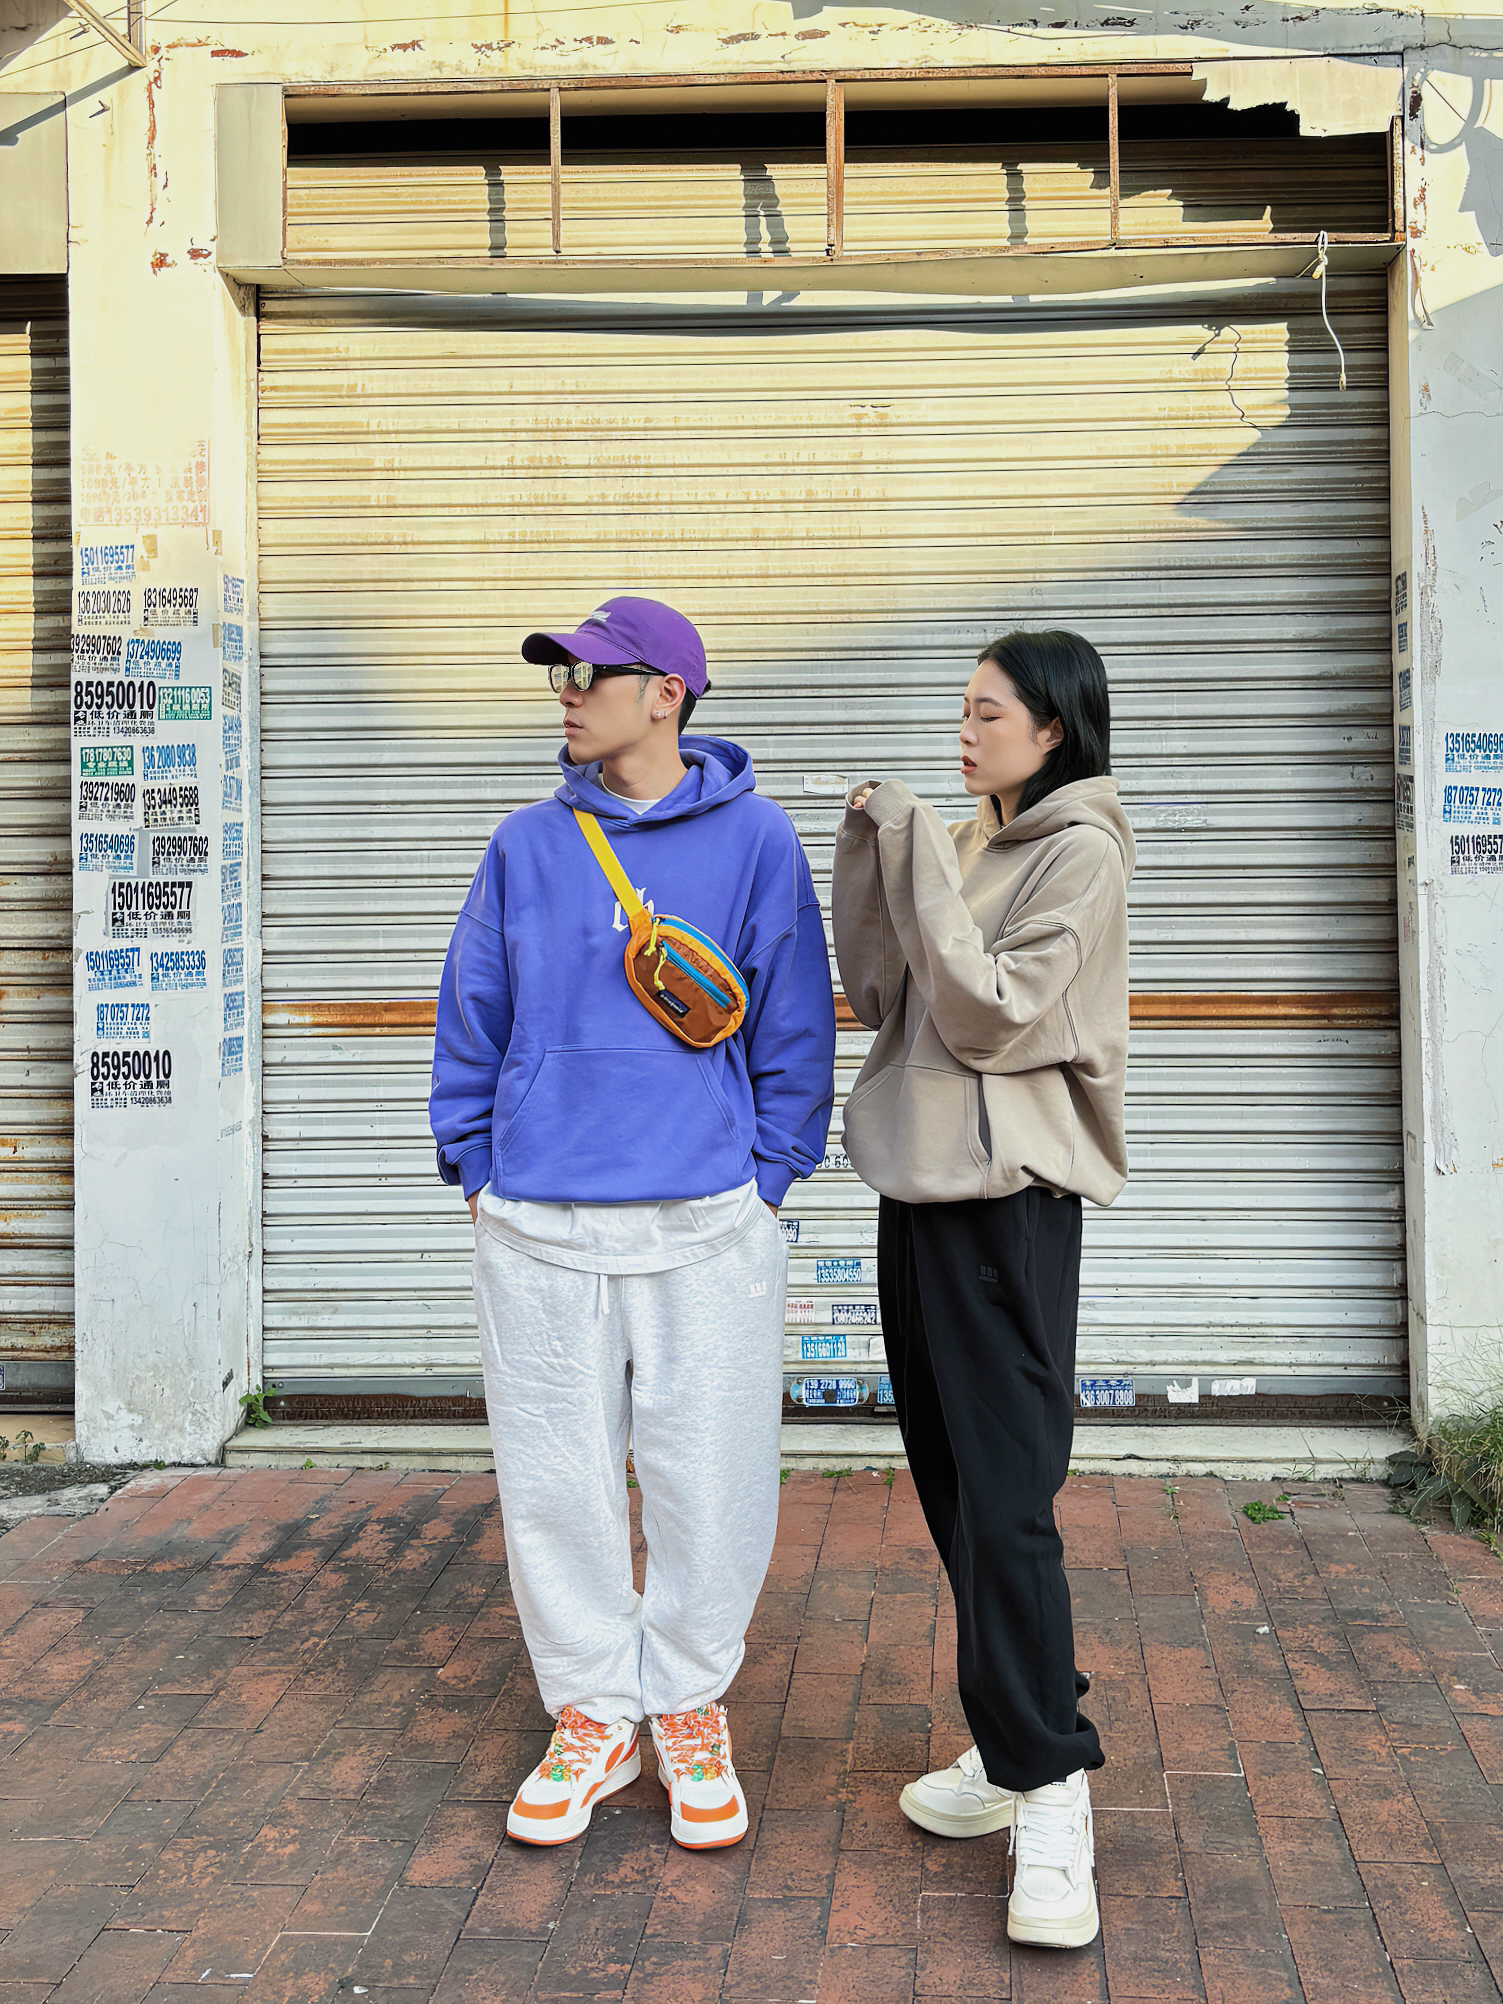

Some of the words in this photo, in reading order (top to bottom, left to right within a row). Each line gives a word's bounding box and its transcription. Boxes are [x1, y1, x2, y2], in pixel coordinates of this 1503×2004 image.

[80, 544, 135, 566] 15011695577
[126, 637, 182, 661] 13724906699
[74, 680, 156, 710] 85950010
[89, 710, 154, 720] 低价通厕
[79, 780, 136, 803] 13927219600
[79, 832, 136, 854] 13516540696
[152, 835, 209, 857] 13929907602
[111, 880, 193, 911] 15011695577
[127, 911, 190, 920] 低价通厕
[85, 946, 141, 972] 15011695577
[150, 949, 207, 972] 13425853336
[90, 1049, 172, 1081] 85950010
[106, 1080, 170, 1090] 低价通厕
